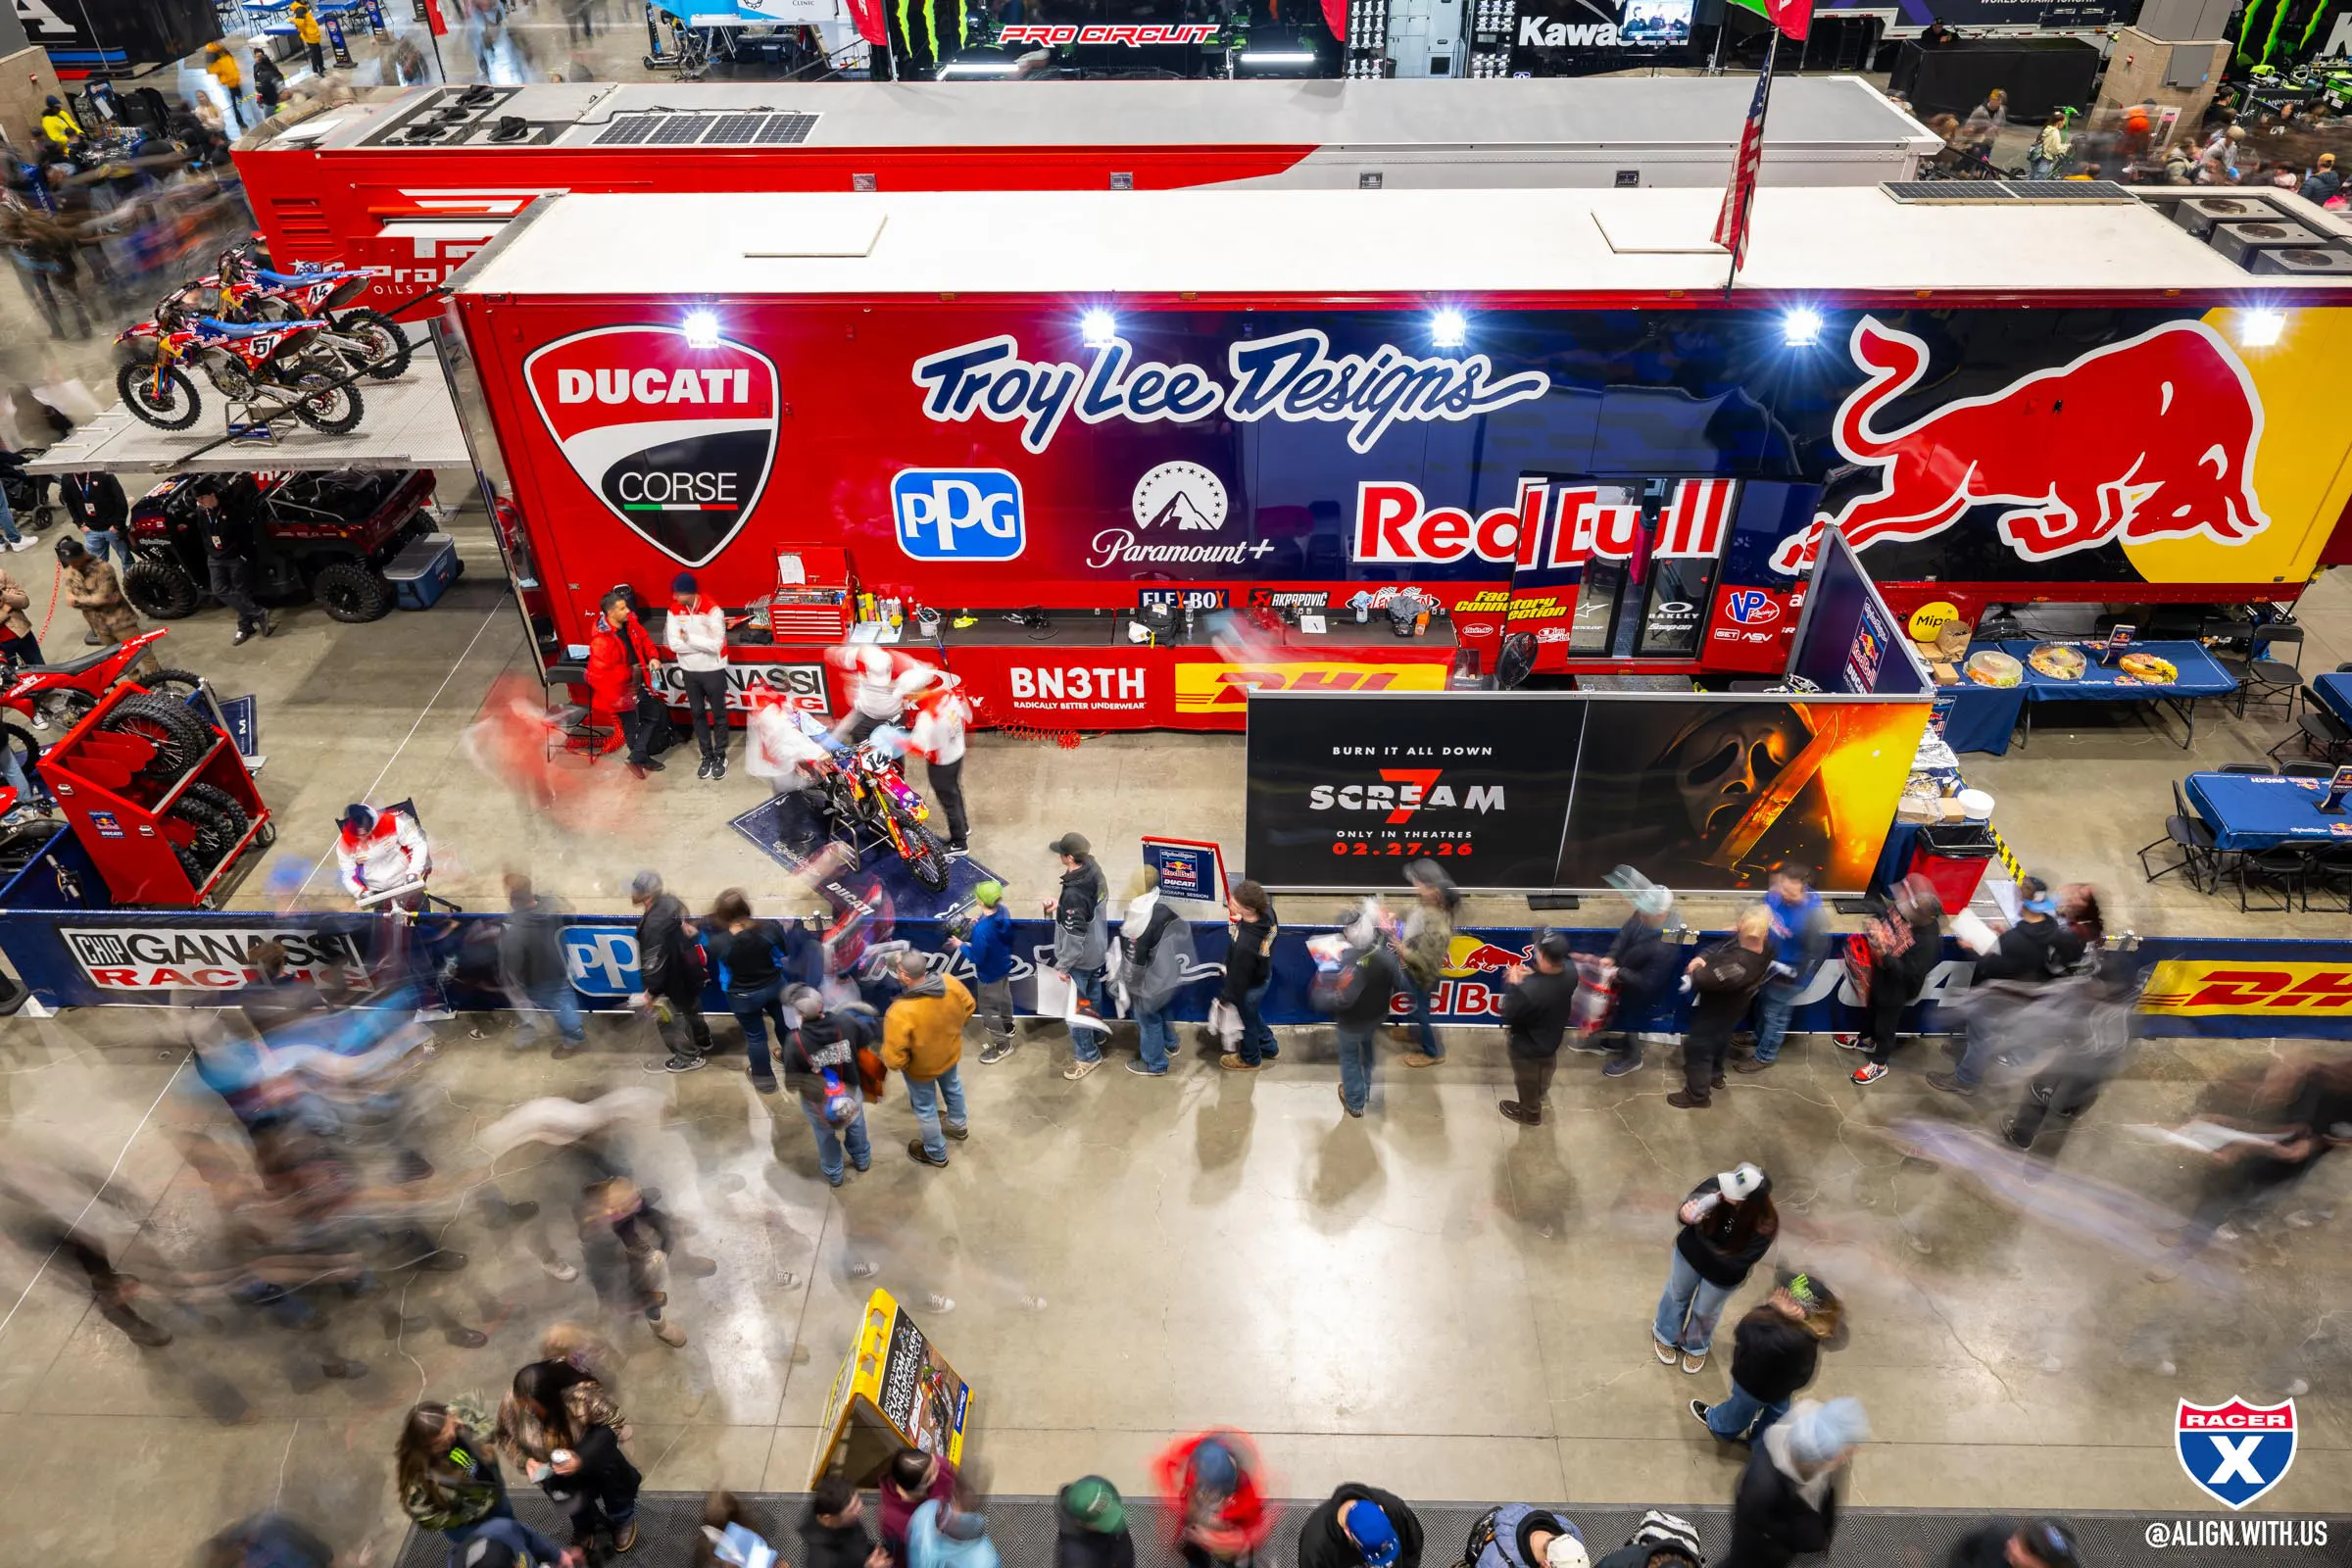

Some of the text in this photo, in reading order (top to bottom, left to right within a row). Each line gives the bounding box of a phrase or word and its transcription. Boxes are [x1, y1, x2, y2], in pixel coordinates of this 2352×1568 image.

[999, 24, 1221, 48] PRO CIRCUIT
[373, 284, 414, 294] OILS
[253, 335, 275, 360] 51
[558, 368, 750, 405] DUCATI
[911, 328, 1551, 455] Troy Lee Designs
[618, 472, 738, 502] CORSE
[901, 479, 1017, 551] PPG
[1352, 477, 1550, 572] Red
[1086, 528, 1275, 568] Paramount+
[1731, 590, 1767, 623] VP
[1741, 632, 1774, 642] ASV
[1010, 667, 1146, 700] BN3TH
[1013, 701, 1057, 710] RADICALLY
[866, 750, 891, 772] 14
[1332, 747, 1493, 756] BURN IT ALL DOWN
[1309, 785, 1505, 815] SCREAM
[1379, 768, 1444, 824] 7
[1332, 842, 1473, 856] 02.27.26
[826, 881, 875, 916] DUCATI
[1164, 879, 1197, 888] DUCATI
[77, 934, 126, 965] CHIP
[565, 933, 642, 989] PP
[1388, 980, 1507, 1017] ed Bu
[2182, 970, 2352, 1007] DH
[888, 1351, 906, 1420] CUSTOM
[894, 1326, 919, 1427] DUNLOP/FALKEN
[900, 1333, 923, 1433] R/C MOTORCYCLE
[884, 1385, 893, 1413] ENTER
